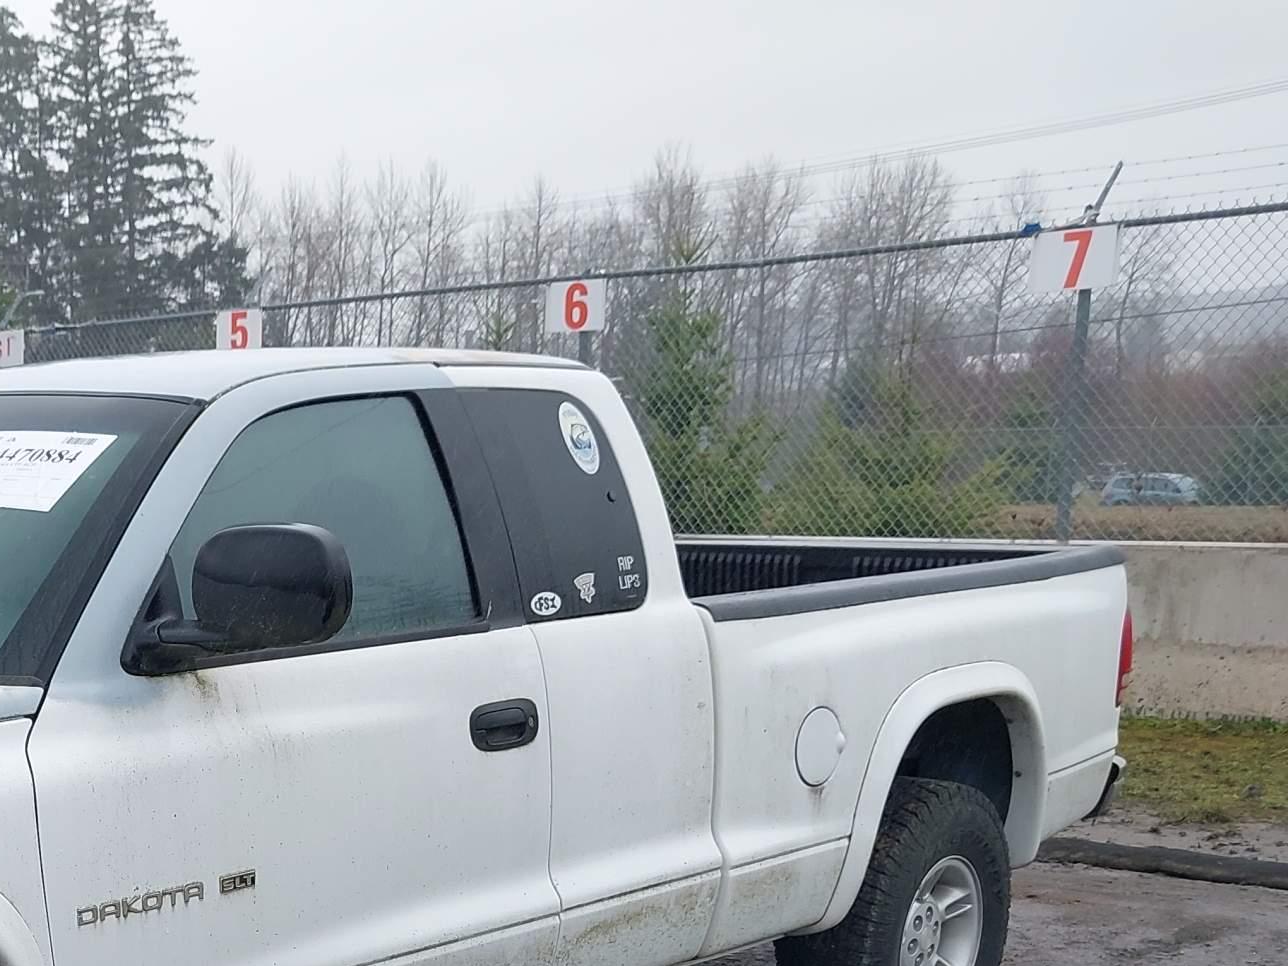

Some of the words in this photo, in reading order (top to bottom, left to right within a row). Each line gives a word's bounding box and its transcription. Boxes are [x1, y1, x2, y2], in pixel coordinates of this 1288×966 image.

[1064, 230, 1093, 288] 7
[565, 283, 588, 330] 6
[231, 312, 248, 349] 5
[617, 555, 634, 571] RIP
[76, 881, 204, 927] DAKOTA
[221, 871, 255, 892] SLT
